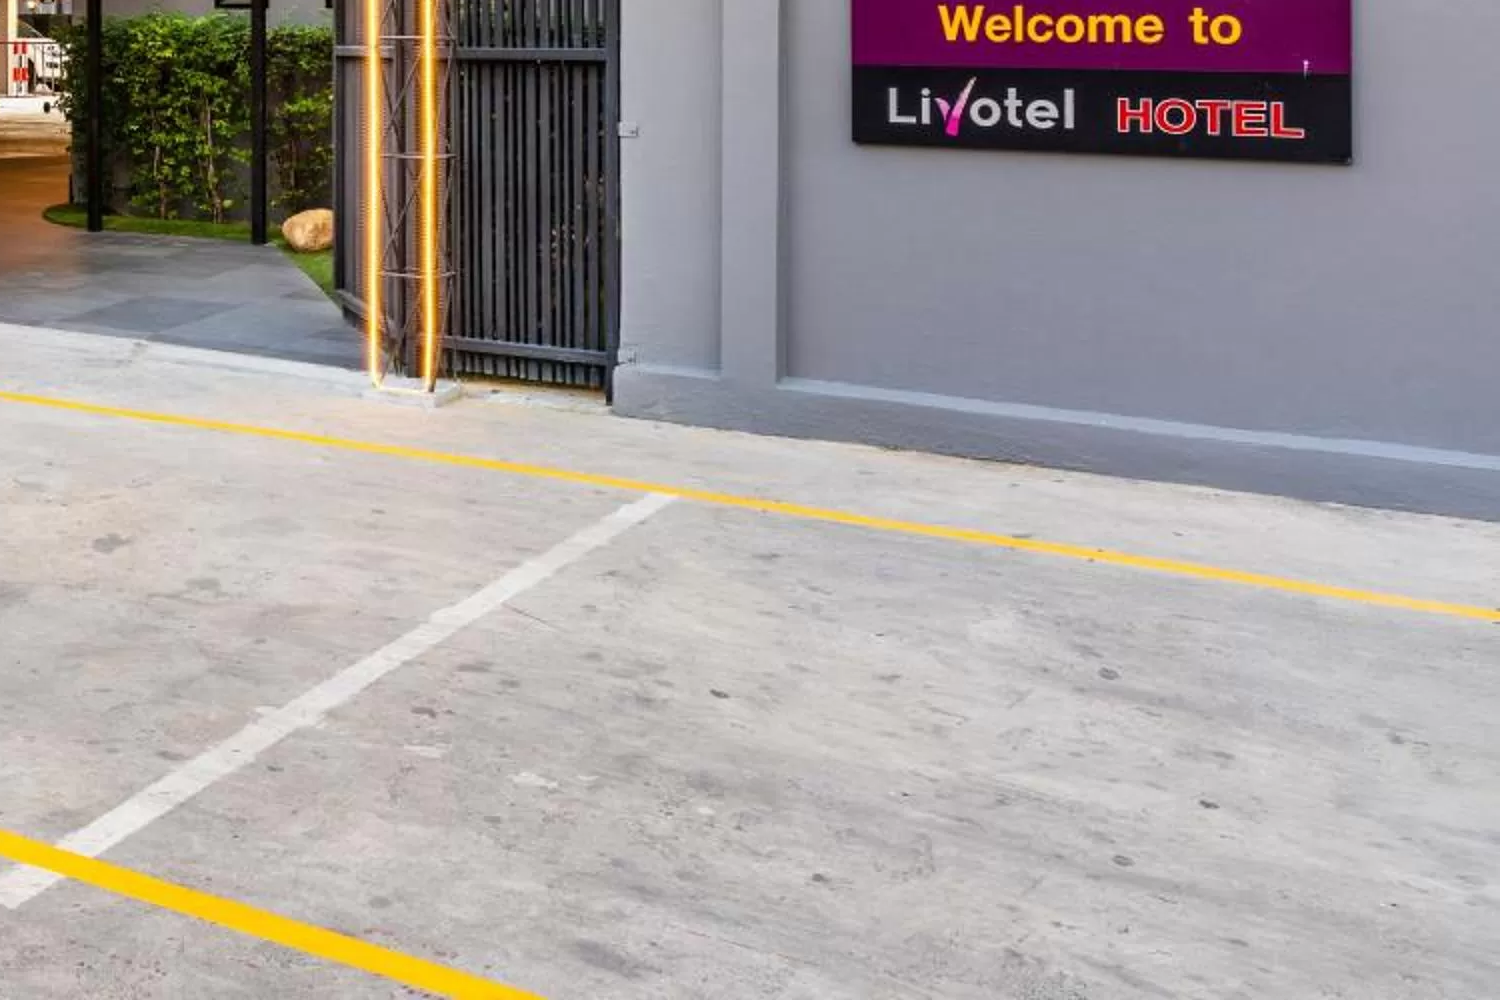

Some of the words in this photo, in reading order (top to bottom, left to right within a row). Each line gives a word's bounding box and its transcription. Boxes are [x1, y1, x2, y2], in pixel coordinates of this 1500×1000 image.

[938, 4, 1165, 45] Welcome
[1189, 6, 1242, 45] to
[1116, 97, 1306, 139] HOTEL
